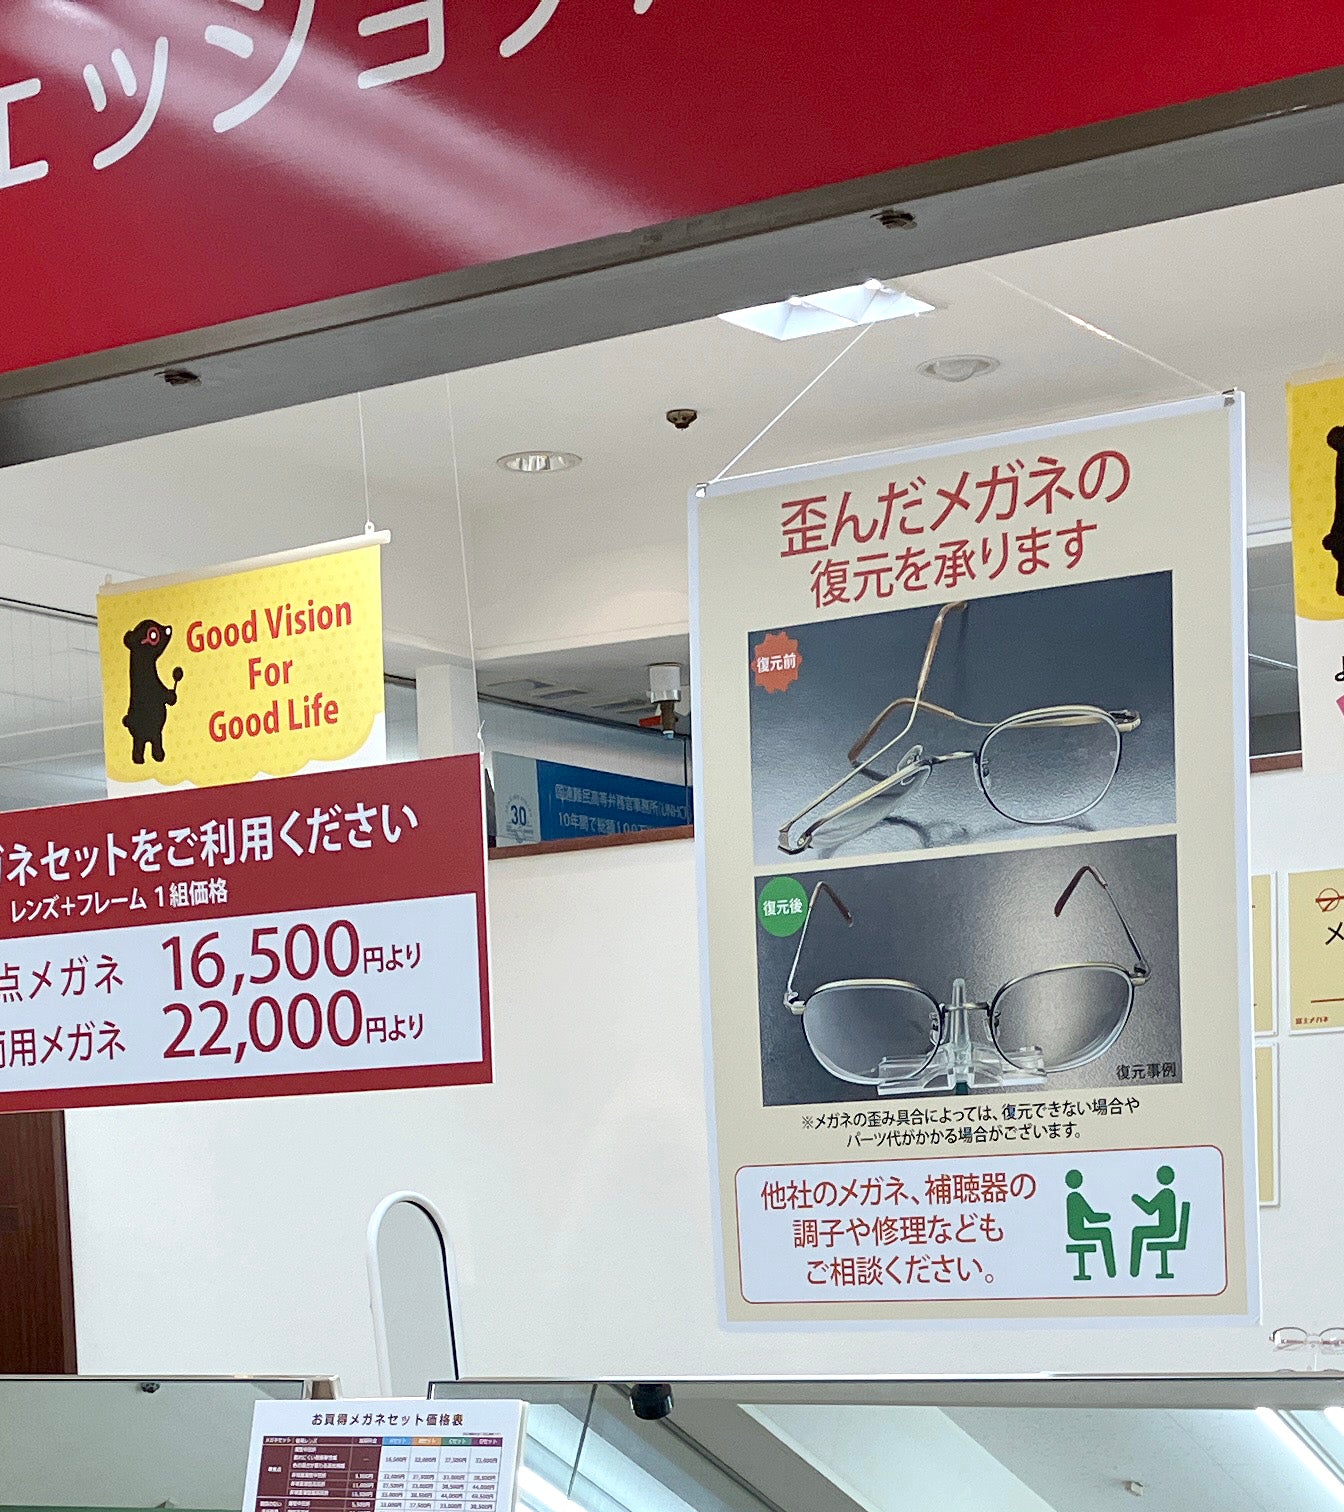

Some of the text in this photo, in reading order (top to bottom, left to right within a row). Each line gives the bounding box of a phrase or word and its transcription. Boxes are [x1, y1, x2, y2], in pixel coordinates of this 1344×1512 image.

[780, 449, 1131, 558] 歪んだメガネの
[810, 518, 1098, 609] 復元を承ります
[186, 600, 352, 653] Good Vision
[249, 658, 293, 690] For
[756, 652, 797, 674] 復元前
[209, 692, 339, 743] Good Life
[763, 897, 804, 917] 復元後
[1116, 1061, 1177, 1082] 復元事例
[846, 1121, 1082, 1149] パーツ代がかかる場合がございます。
[760, 1172, 1037, 1212] 他社のメガネ、補聴器の
[792, 1211, 1004, 1249] 調子や修理なども
[806, 1256, 996, 1288] ご相談ください。
[311, 1413, 464, 1427] お買得メガネセット価格表
